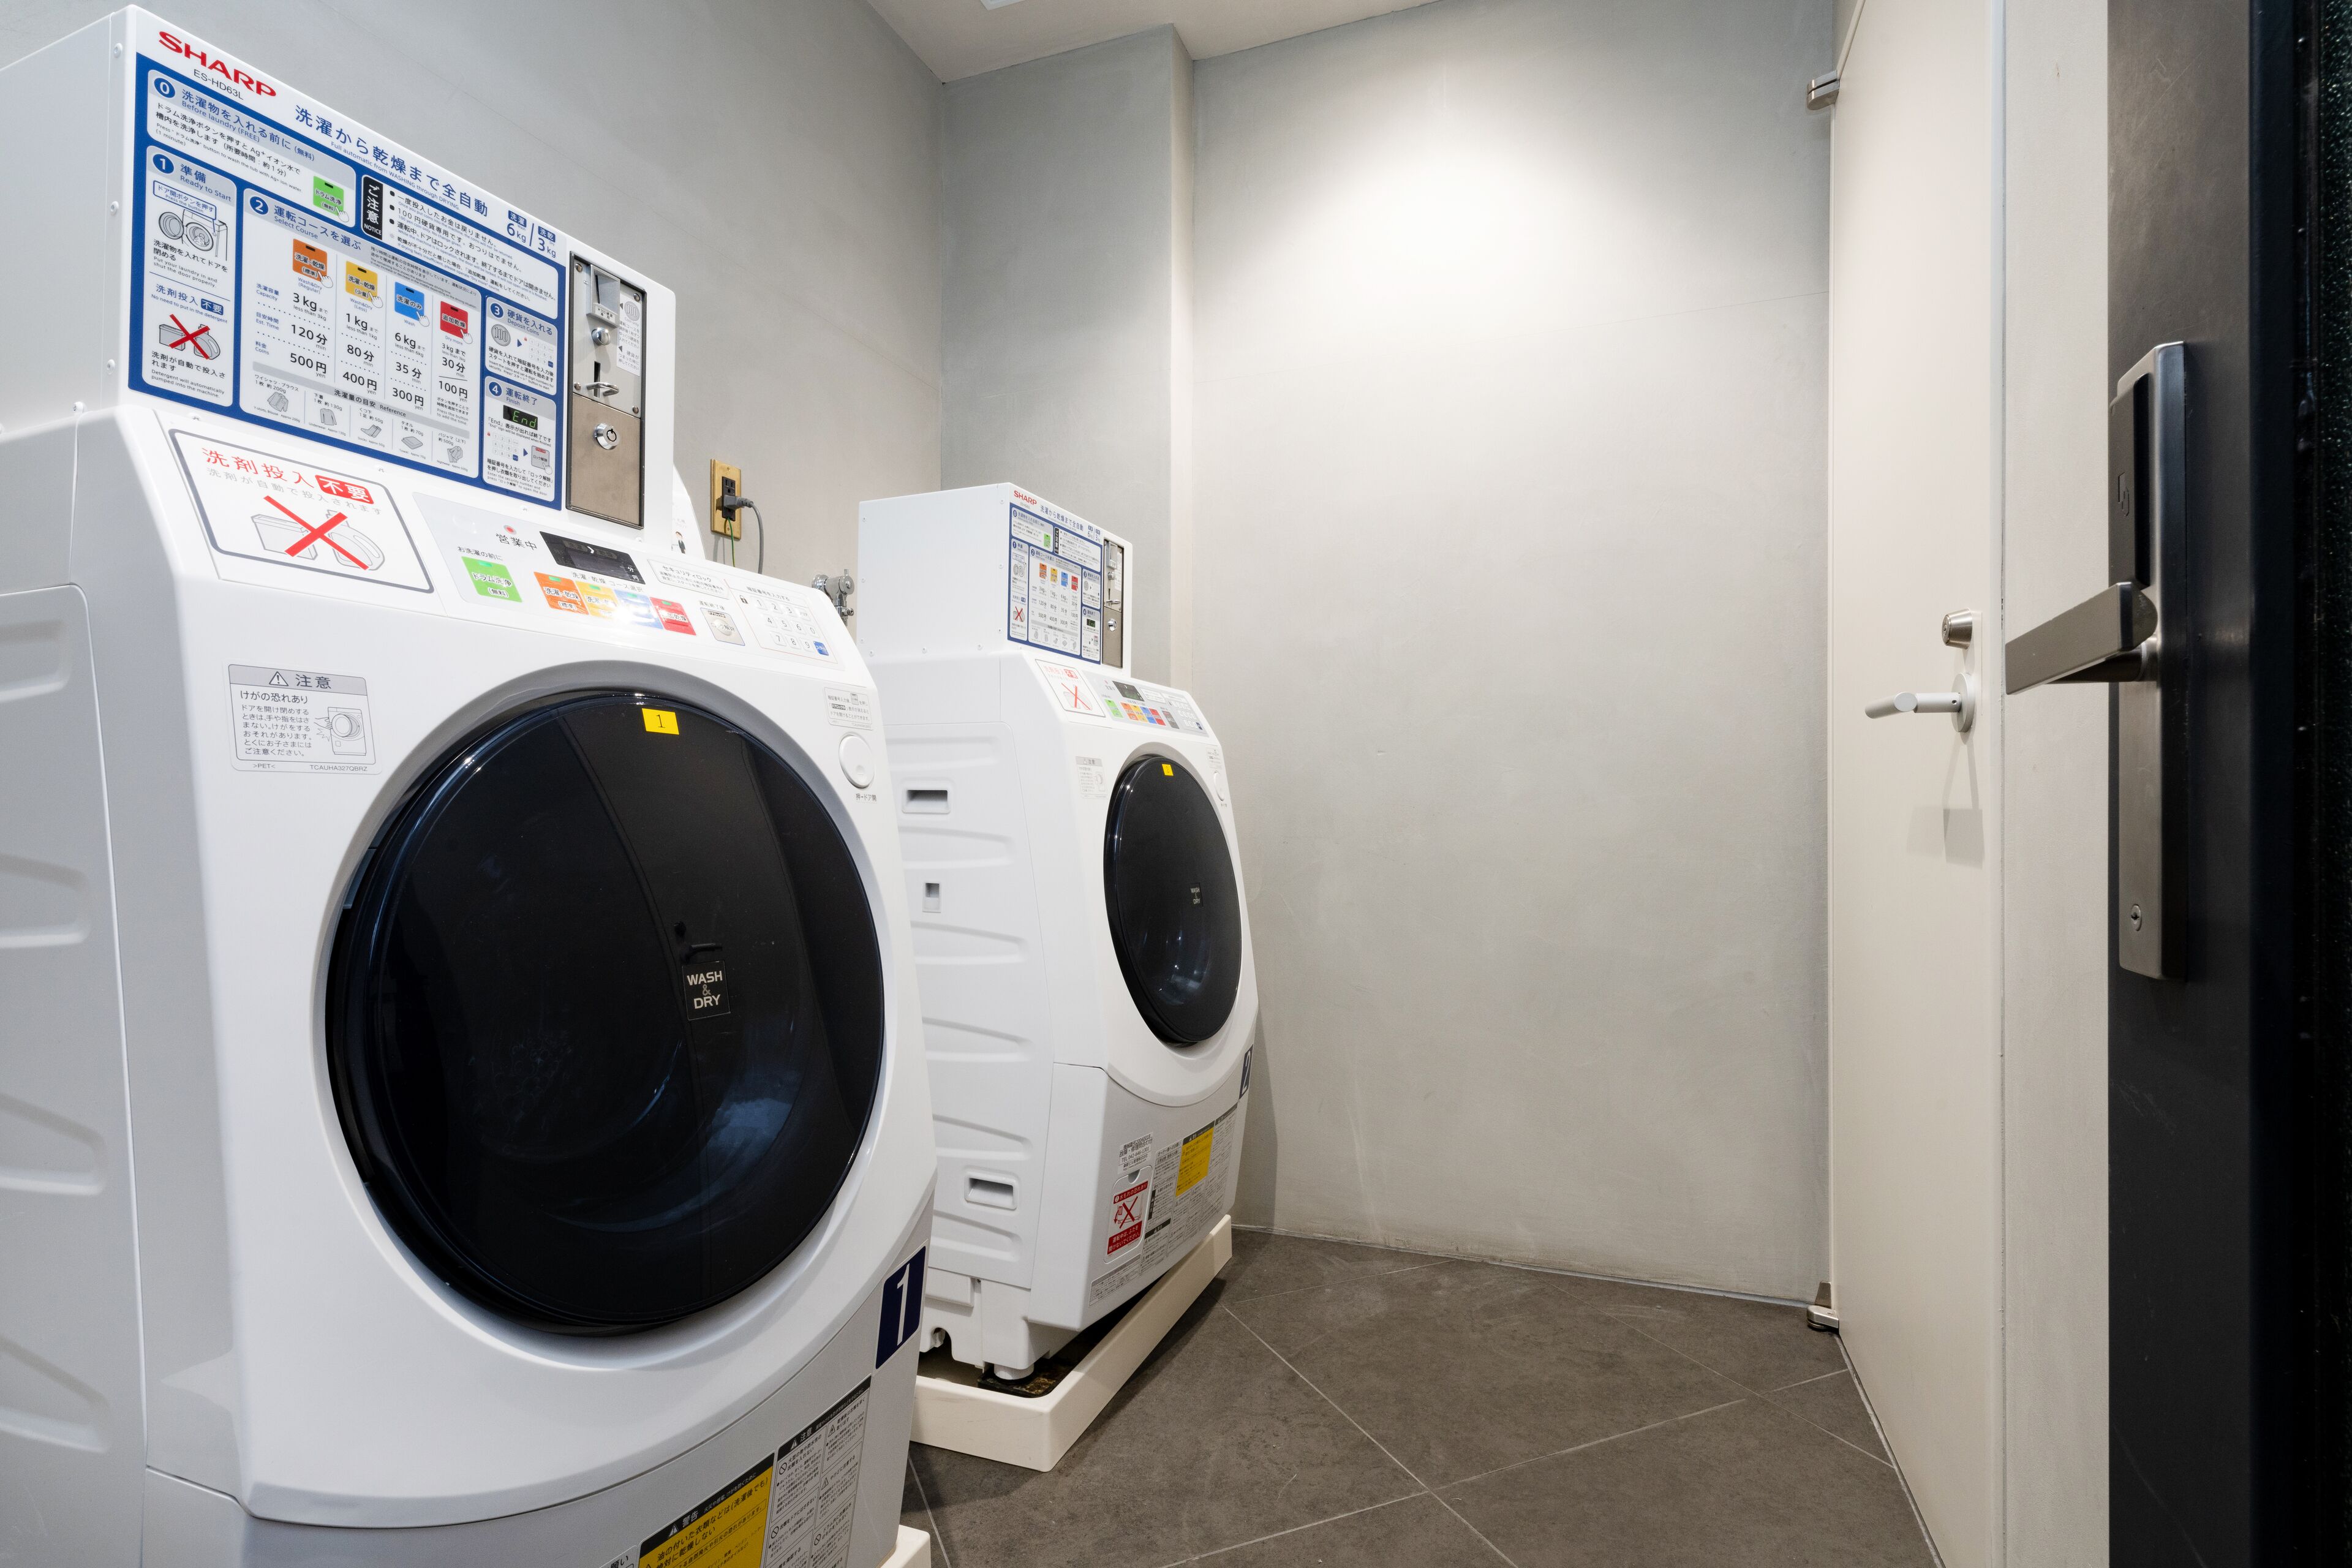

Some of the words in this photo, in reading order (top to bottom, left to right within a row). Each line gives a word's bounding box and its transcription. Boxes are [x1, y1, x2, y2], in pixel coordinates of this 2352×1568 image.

[159, 31, 277, 97] SHARP
[160, 80, 169, 96] 0
[193, 68, 243, 100] ES-HD63L
[181, 88, 291, 151] 洗濯物を入れる前に
[181, 99, 206, 118] Before
[208, 113, 236, 132] laundry
[237, 126, 260, 143] (FREE)
[159, 156, 165, 170] 1
[295, 103, 488, 218] 洗濯から乾燥まで全自動
[180, 162, 206, 184] 準備
[331, 141, 342, 151] Full
[342, 146, 372, 167] automatic
[374, 162, 387, 174] from
[388, 170, 415, 188] WASHING
[416, 184, 437, 200] through
[439, 195, 460, 211] DRYING.
[180, 175, 203, 191] Ready
[205, 186, 213, 194] to
[214, 189, 231, 202] Start
[157, 184, 214, 213] ドア開ボタンを押す
[315, 188, 342, 206] ドラム洗浄
[366, 181, 379, 225] ご注意
[255, 198, 263, 213] 2
[398, 193, 497, 248] 一度投入したお金は戻りません。
[510, 211, 526, 226] 洗濯
[274, 215, 293, 229] Select
[295, 225, 318, 239] Course
[274, 204, 361, 252] 運転コースを選ぶ
[364, 222, 382, 236] NOTICE
[540, 227, 554, 241] 洗乾
[153, 247, 176, 262] 閉める
[153, 238, 228, 273] 洗濯物を入れてドアを
[256, 282, 279, 296] 洗濯容量
[298, 277, 322, 291] Wash&Dry
[156, 283, 198, 306] 洗剤投入
[202, 299, 222, 315] 不要
[256, 288, 277, 302] Capacity
[293, 292, 300, 304] 3
[303, 295, 317, 312] kg
[396, 294, 422, 311] 洗濯のみ
[350, 297, 372, 311] Wash&Dry
[494, 305, 500, 316] 3
[255, 311, 279, 325] 目安時間
[345, 312, 350, 323] 1
[355, 315, 368, 331] kg
[404, 318, 415, 327] Wash
[442, 313, 466, 329] 追加乾燥
[507, 308, 552, 336] 硬貨を入れる
[266, 322, 279, 331] Time
[507, 318, 526, 331] Deposit
[526, 326, 539, 336] Coins
[255, 340, 266, 349] 料金
[394, 331, 401, 342] 6
[404, 334, 416, 350] kg
[255, 345, 270, 355] Coins
[151, 350, 225, 379] 洗剤が自動で投入さ
[151, 358, 176, 372] れます
[290, 352, 326, 374] 500円
[488, 345, 554, 377] 硬貨を入れて暗証番号を入力後
[488, 352, 554, 383] スタートを押すと運転を始めます
[342, 369, 377, 391] 400円
[392, 386, 424, 407] 300円
[439, 379, 467, 399] 100円
[492, 383, 499, 394] 4
[505, 386, 537, 407] 運転終了
[334, 388, 376, 409] 洗濯量の目安
[380, 404, 406, 418] Reference
[506, 396, 520, 406] Finish
[512, 409, 537, 429] End
[200, 447, 314, 488] 洗剤投入
[318, 477, 372, 502] 不要
[487, 464, 551, 489] を押し衣類を取り出してください
[205, 466, 384, 516] 洗剤が自動で投入されます
[1014, 490, 1037, 505] SHARP
[496, 533, 537, 551] 営業中
[458, 546, 503, 561] お洗濯の前に
[472, 573, 512, 587] ドラム洗浄
[662, 566, 711, 582] セキュリティロック
[747, 586, 790, 601] 暗証番号を入力する
[295, 674, 331, 689] 注意
[240, 691, 308, 704] けがの恐れあり
[241, 704, 309, 715] ドアを開け閉めする
[242, 714, 310, 724] ときは、手や指をはさ
[243, 722, 311, 732] まない。けがをする
[656, 714, 666, 728] 1
[243, 731, 312, 741] おそれがあります。
[244, 739, 312, 748] とくにお子さまには
[245, 748, 304, 757] ご注意ください。
[687, 970, 723, 986] WASH
[702, 984, 711, 996] &
[693, 994, 721, 1009] DRY
[1242, 1050, 1251, 1095] 2
[897, 1263, 910, 1346] 1
[801, 1427, 813, 1441] 注意
[682, 1511, 698, 1528] 警告
